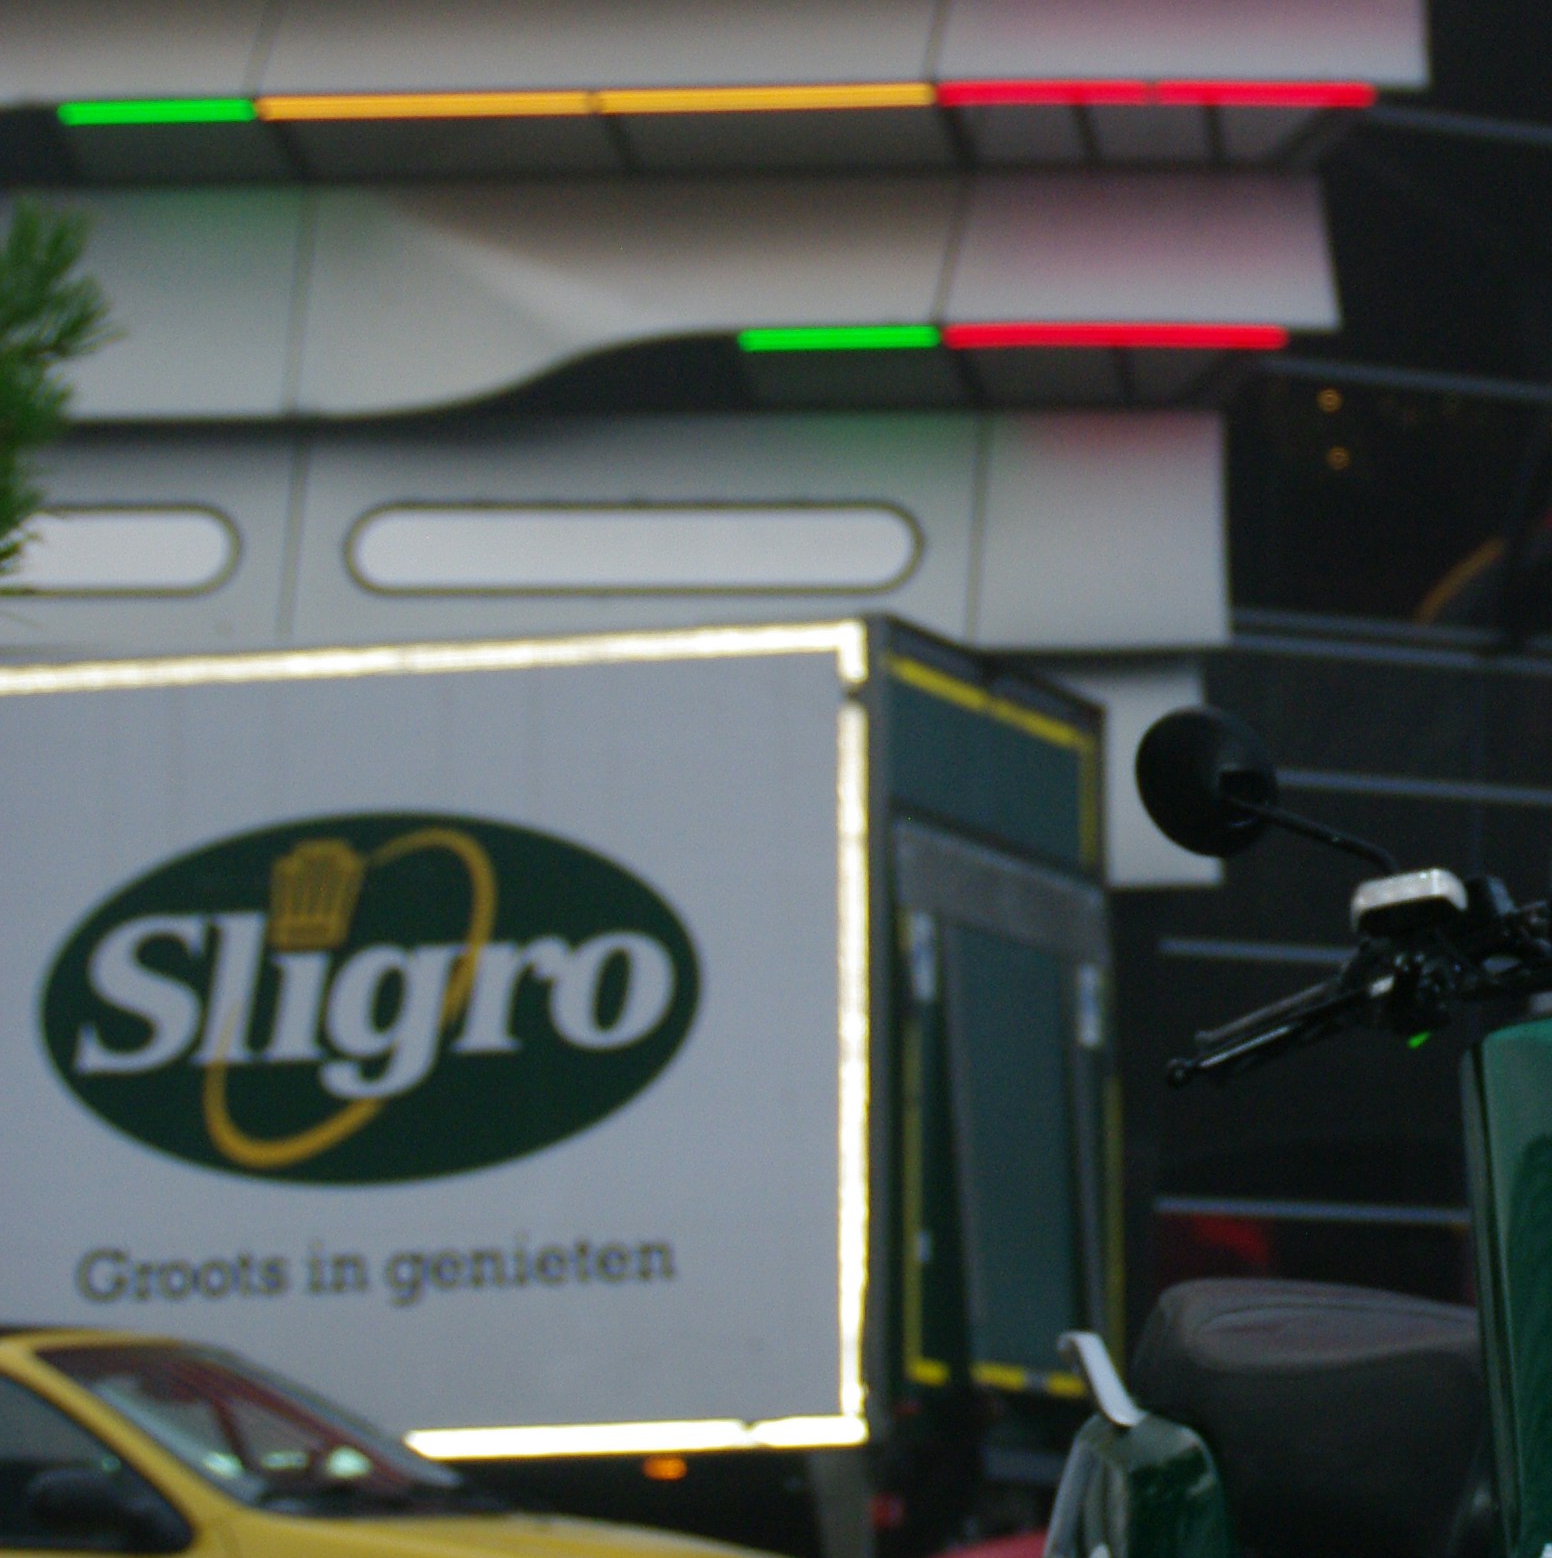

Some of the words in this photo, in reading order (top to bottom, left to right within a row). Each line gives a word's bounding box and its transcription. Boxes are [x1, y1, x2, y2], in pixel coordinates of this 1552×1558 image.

[74, 910, 677, 1099] Sligro
[76, 1249, 289, 1304] Groots
[306, 1242, 369, 1295] in
[387, 1236, 676, 1305] genieten
